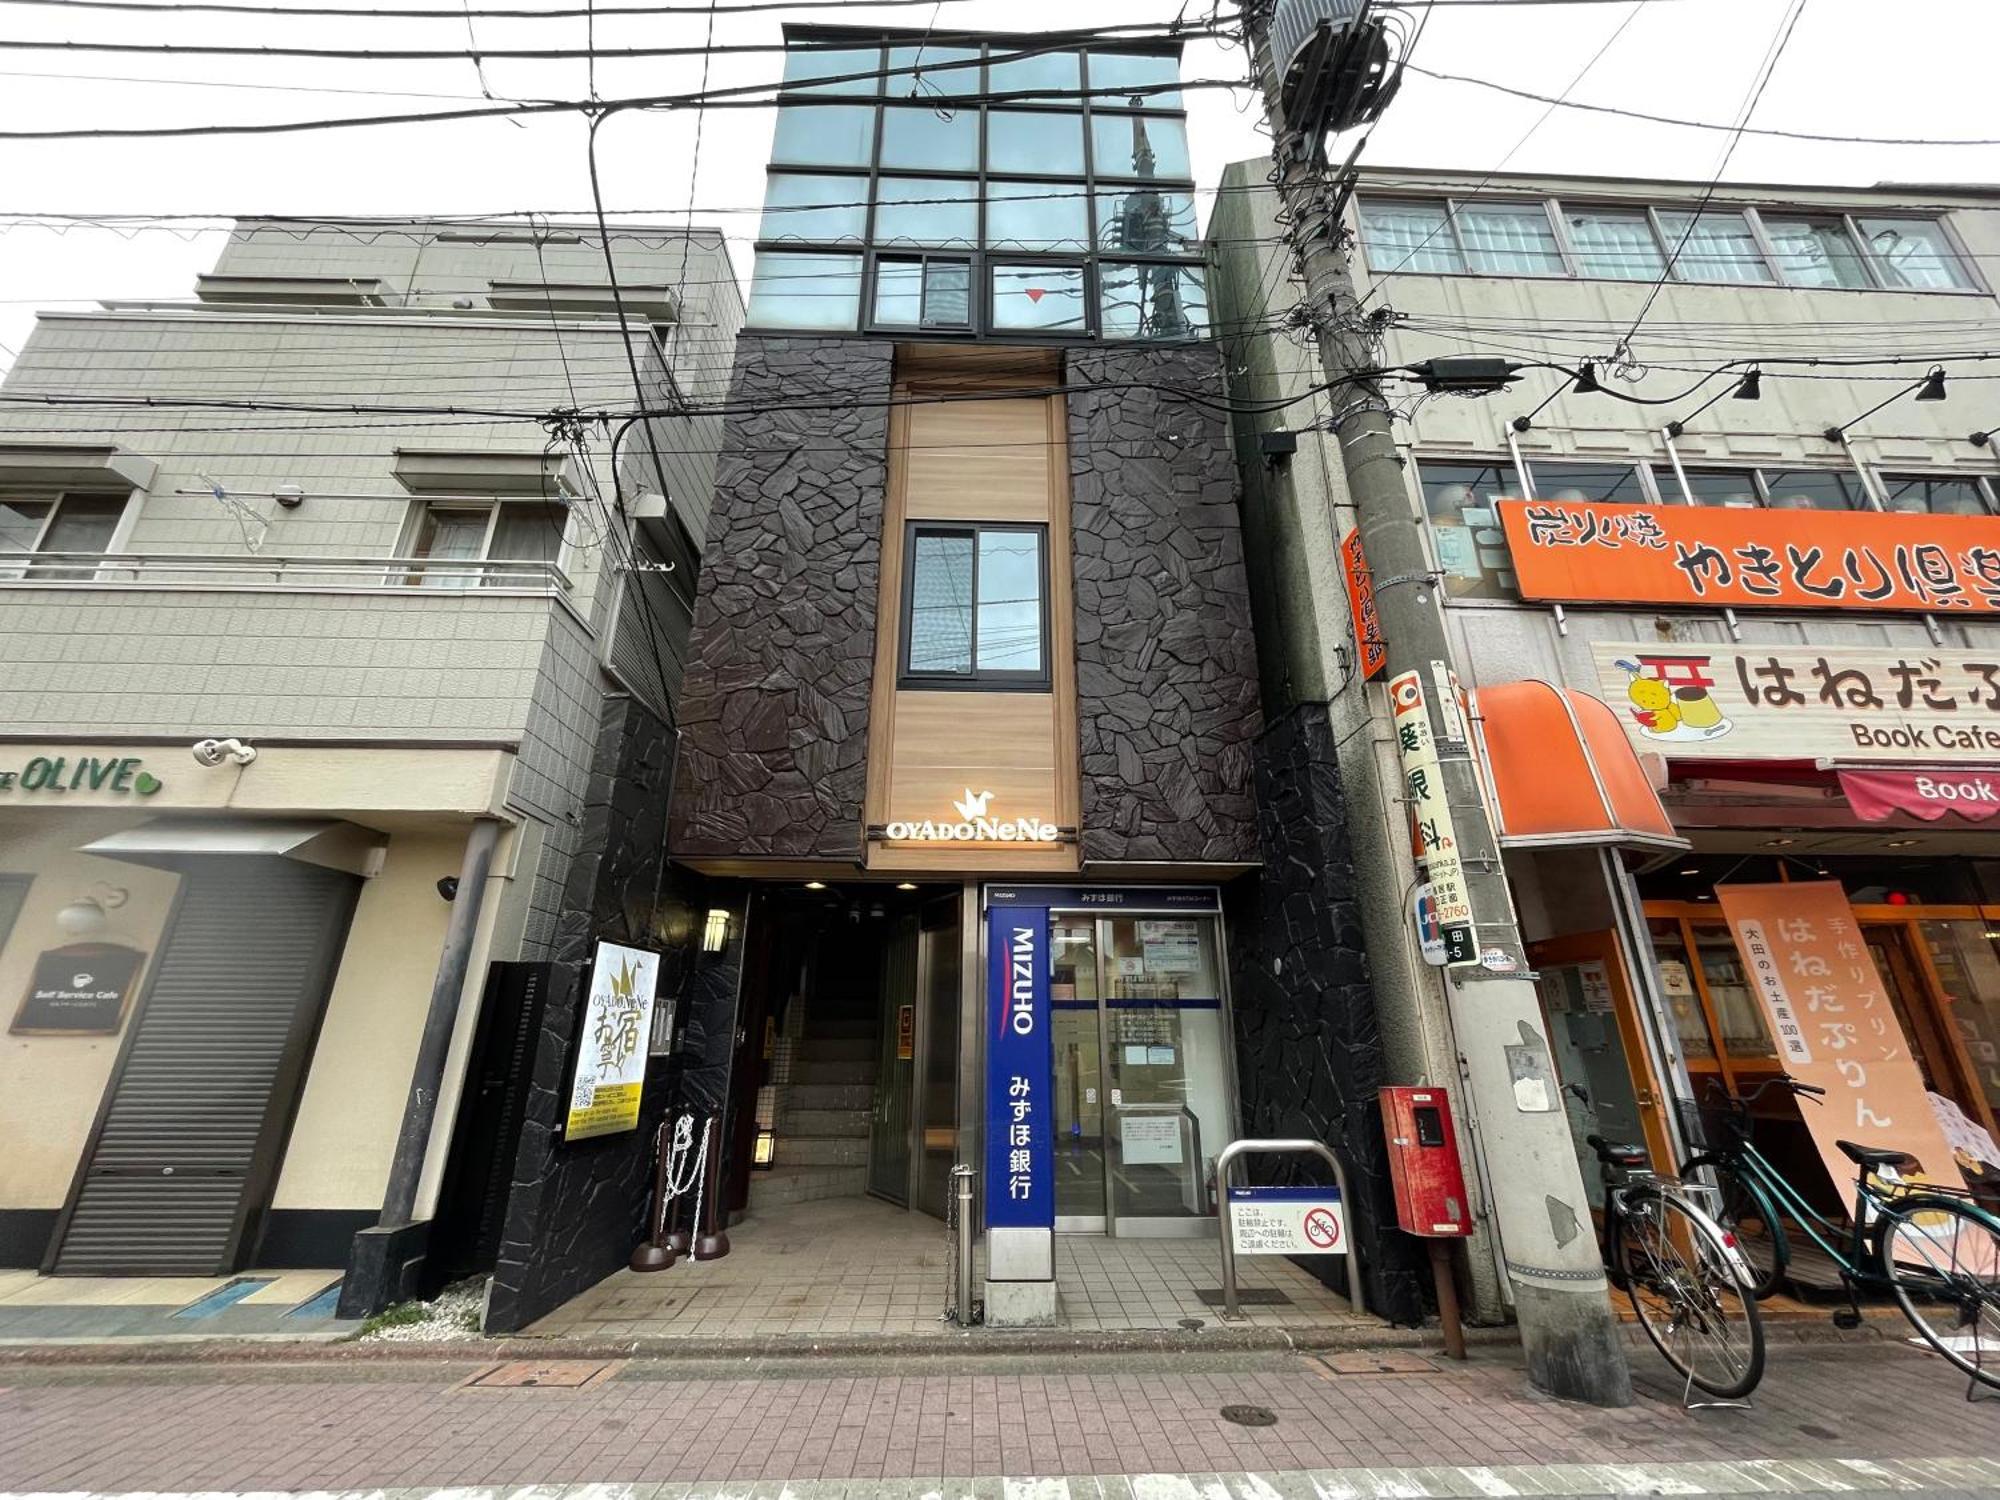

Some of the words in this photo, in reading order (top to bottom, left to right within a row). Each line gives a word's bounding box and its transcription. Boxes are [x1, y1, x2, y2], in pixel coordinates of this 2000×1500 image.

[1850, 723, 1930, 749] Book
[20, 756, 142, 790] OLIVE
[1914, 776, 1999, 801] Book
[1437, 904, 1469, 920] -2760
[1012, 927, 1034, 1036] MIZUHO
[1777, 918, 1893, 1128] はねだぷりん
[1009, 1076, 1032, 1199] みずほ銀行
